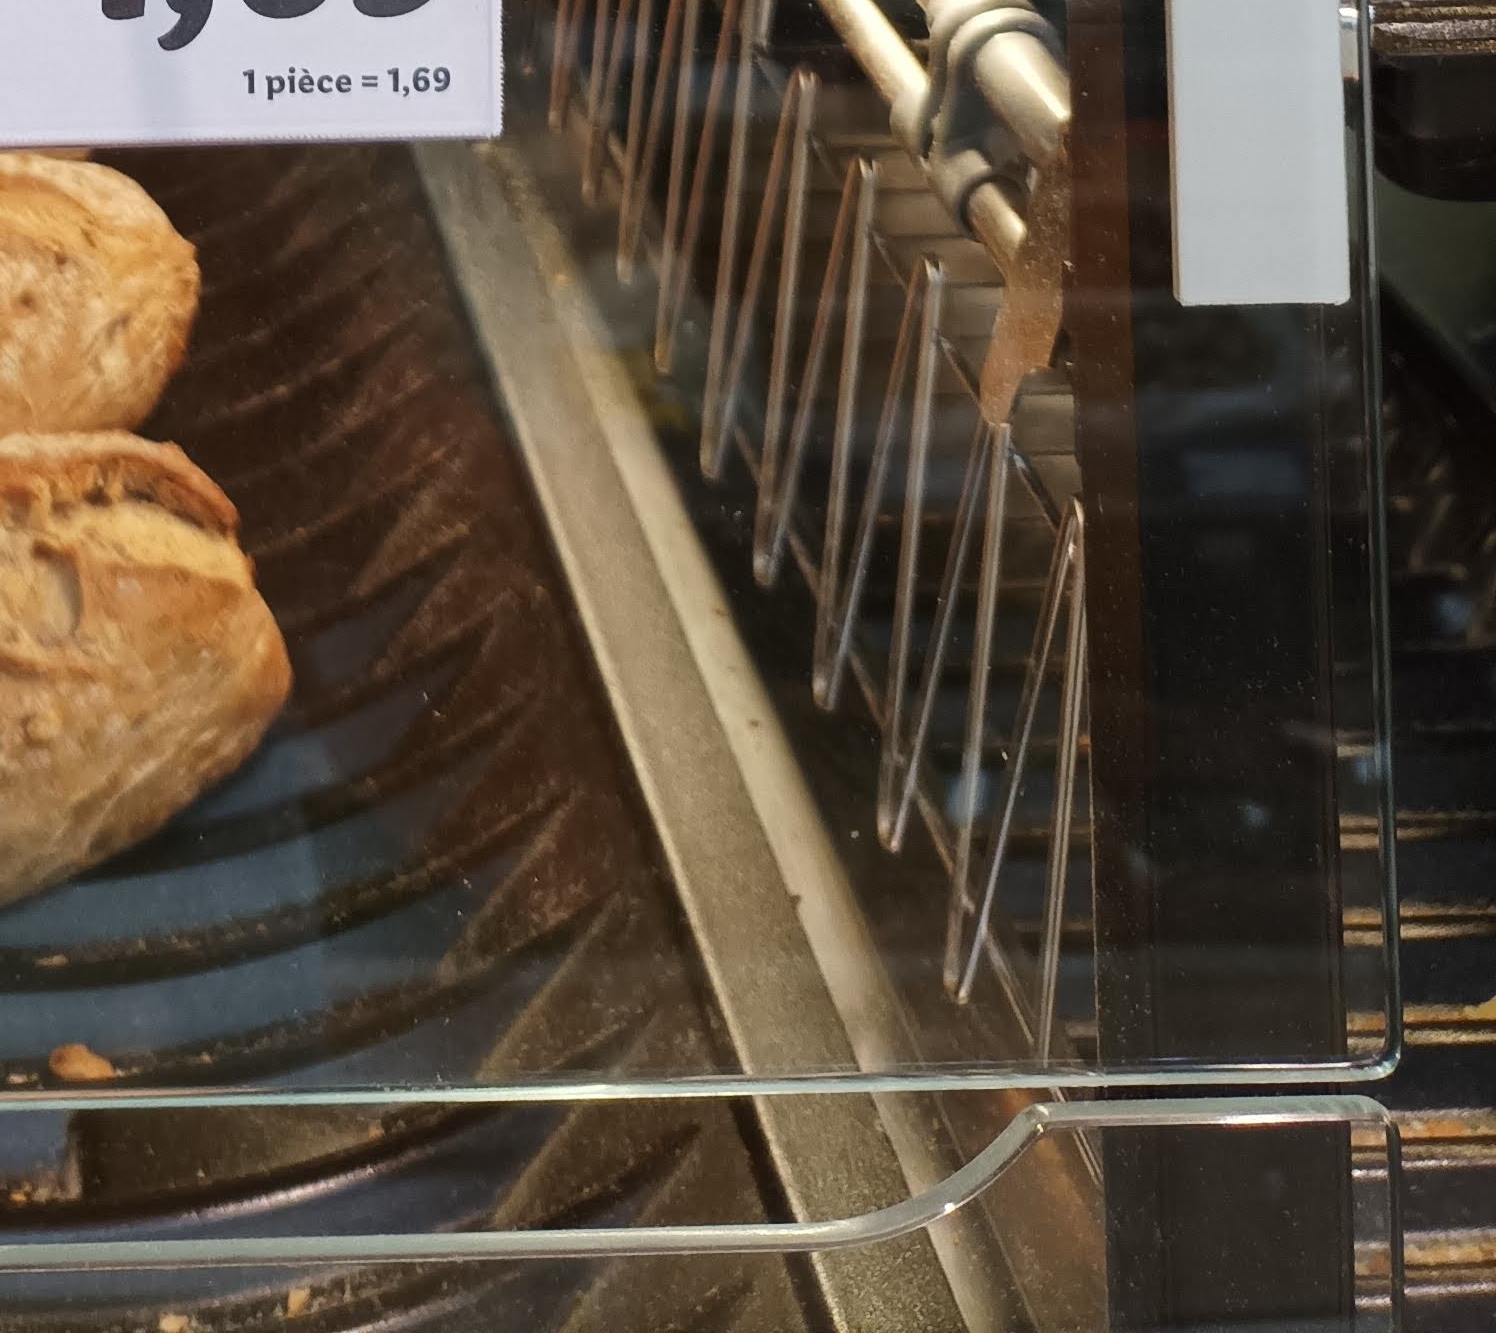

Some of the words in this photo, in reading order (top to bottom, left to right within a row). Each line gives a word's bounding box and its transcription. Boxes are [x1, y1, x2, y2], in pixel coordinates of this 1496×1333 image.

[242, 69, 255, 94] 1
[265, 66, 352, 101] pièce
[387, 66, 451, 97] 1,69
